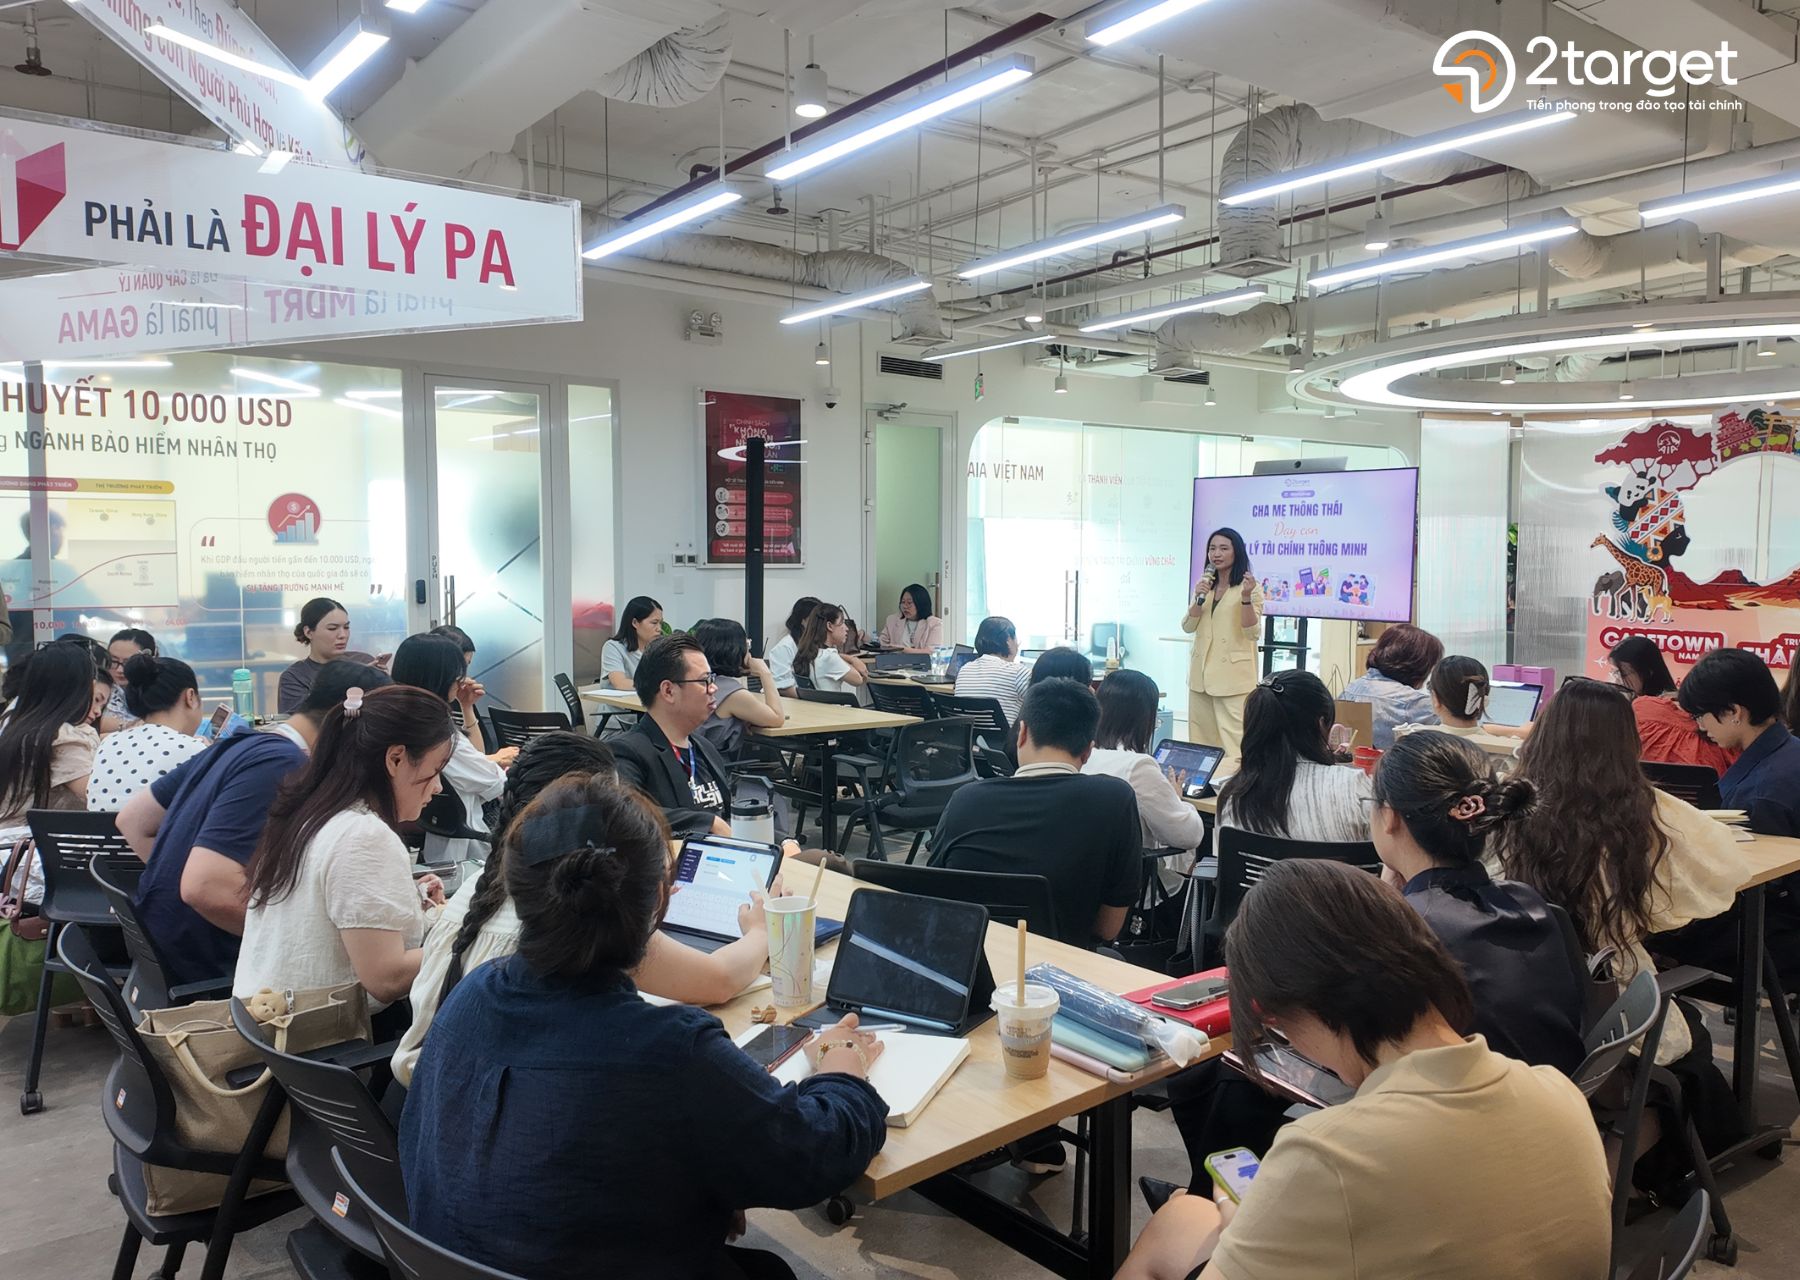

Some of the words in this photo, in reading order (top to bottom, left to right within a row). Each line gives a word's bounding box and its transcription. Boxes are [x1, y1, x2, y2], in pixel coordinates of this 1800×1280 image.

[228, 80, 250, 128] Phù
[253, 102, 274, 150] Hợp
[84, 199, 174, 246] PHẢI
[186, 208, 231, 253] LÀ
[241, 194, 344, 276] ĐẠI
[367, 202, 427, 275] LÝ
[444, 223, 516, 287] PA
[2, 375, 112, 417] HUYẾT
[124, 389, 227, 425] 10,000
[238, 397, 292, 428] USD
[15, 427, 84, 451] NGÀNH
[92, 430, 129, 453] BẢO
[136, 432, 181, 456] HIỂM
[188, 437, 238, 458] NHÂN
[244, 442, 277, 463] THỌ
[1658, 446, 1679, 454] AIA
[993, 459, 1017, 483] VIỆT
[1020, 464, 1044, 481] NAM
[1252, 505, 1269, 517] CHA
[1272, 504, 1287, 519] MẸ
[1289, 500, 1319, 517] THÔNG
[1322, 500, 1343, 516] THÁI
[1249, 540, 1260, 556] LÝ
[1262, 540, 1275, 556] TÀI
[1278, 540, 1305, 556] CHÍNH
[1308, 539, 1338, 556] THÔNG
[1341, 543, 1368, 556] MINH
[1679, 652, 1700, 660] NAM
